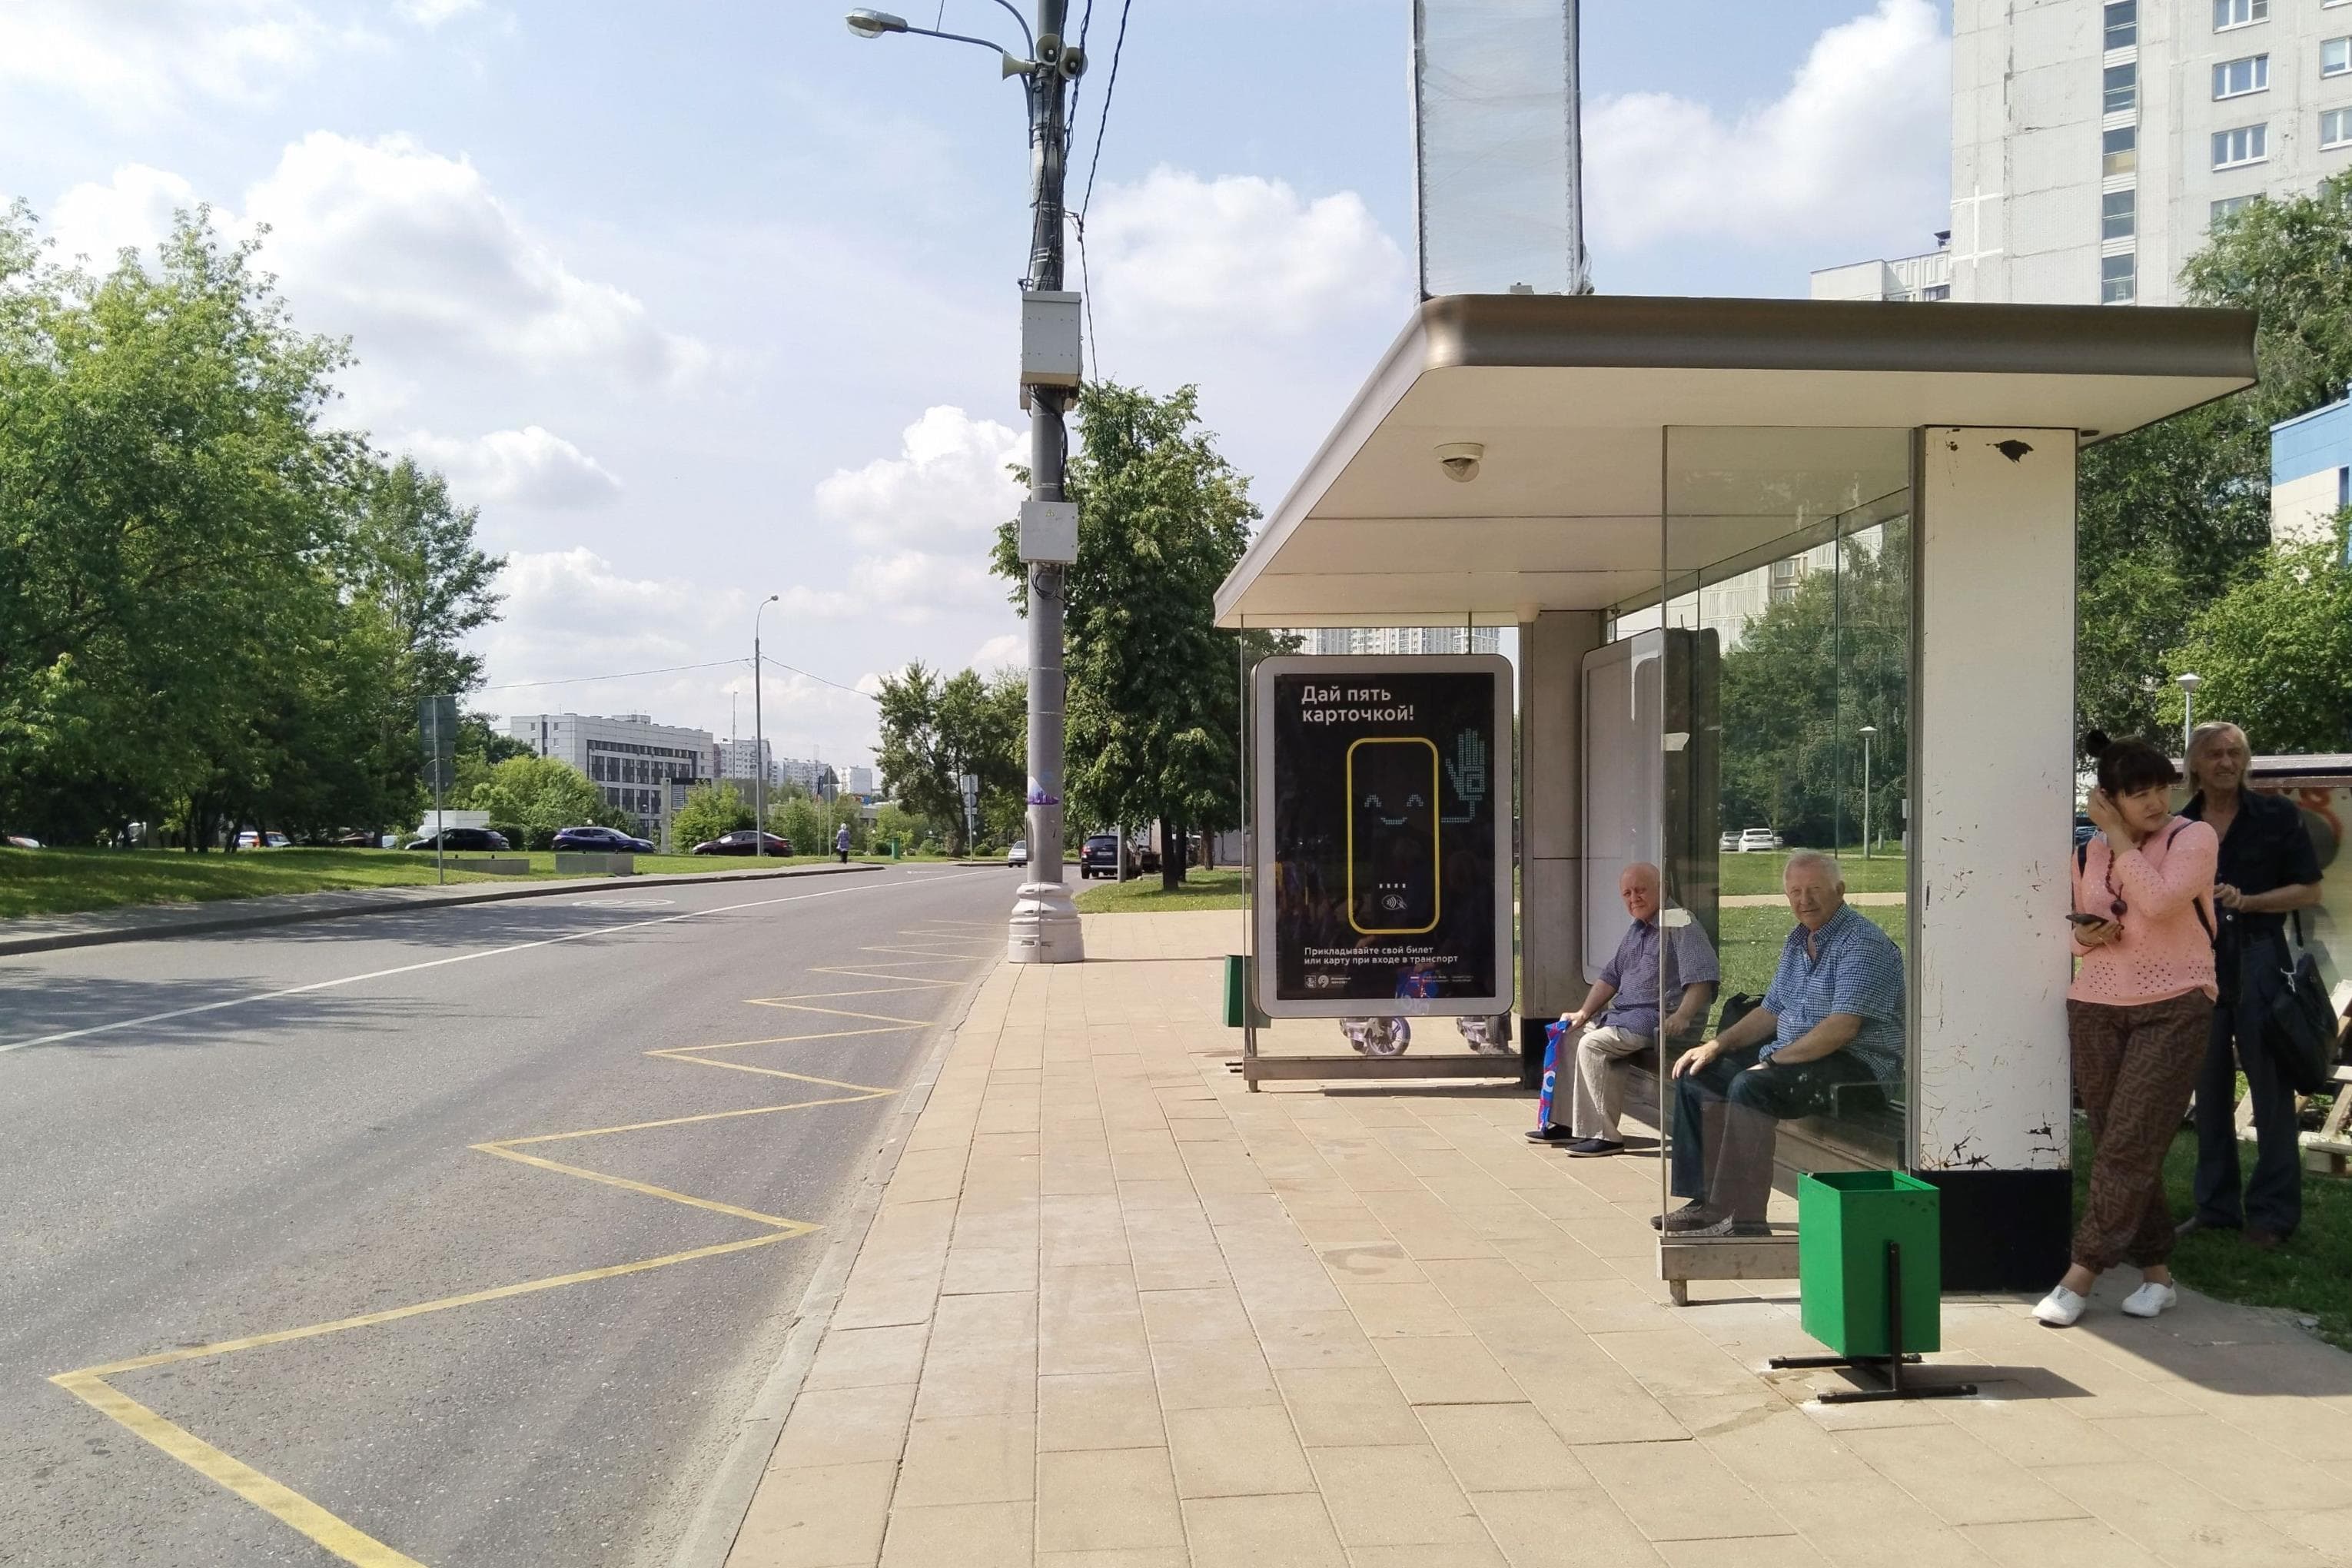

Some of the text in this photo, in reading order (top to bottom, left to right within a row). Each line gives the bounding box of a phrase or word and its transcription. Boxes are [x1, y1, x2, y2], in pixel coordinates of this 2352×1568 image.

[1301, 686, 1391, 705] Дай пять
[1303, 705, 1414, 726] карточкой!
[1304, 947, 1379, 957] Прикладывайте
[1406, 945, 1433, 954] билет
[1353, 957, 1370, 965] при
[1410, 955, 1458, 964] транспорт
